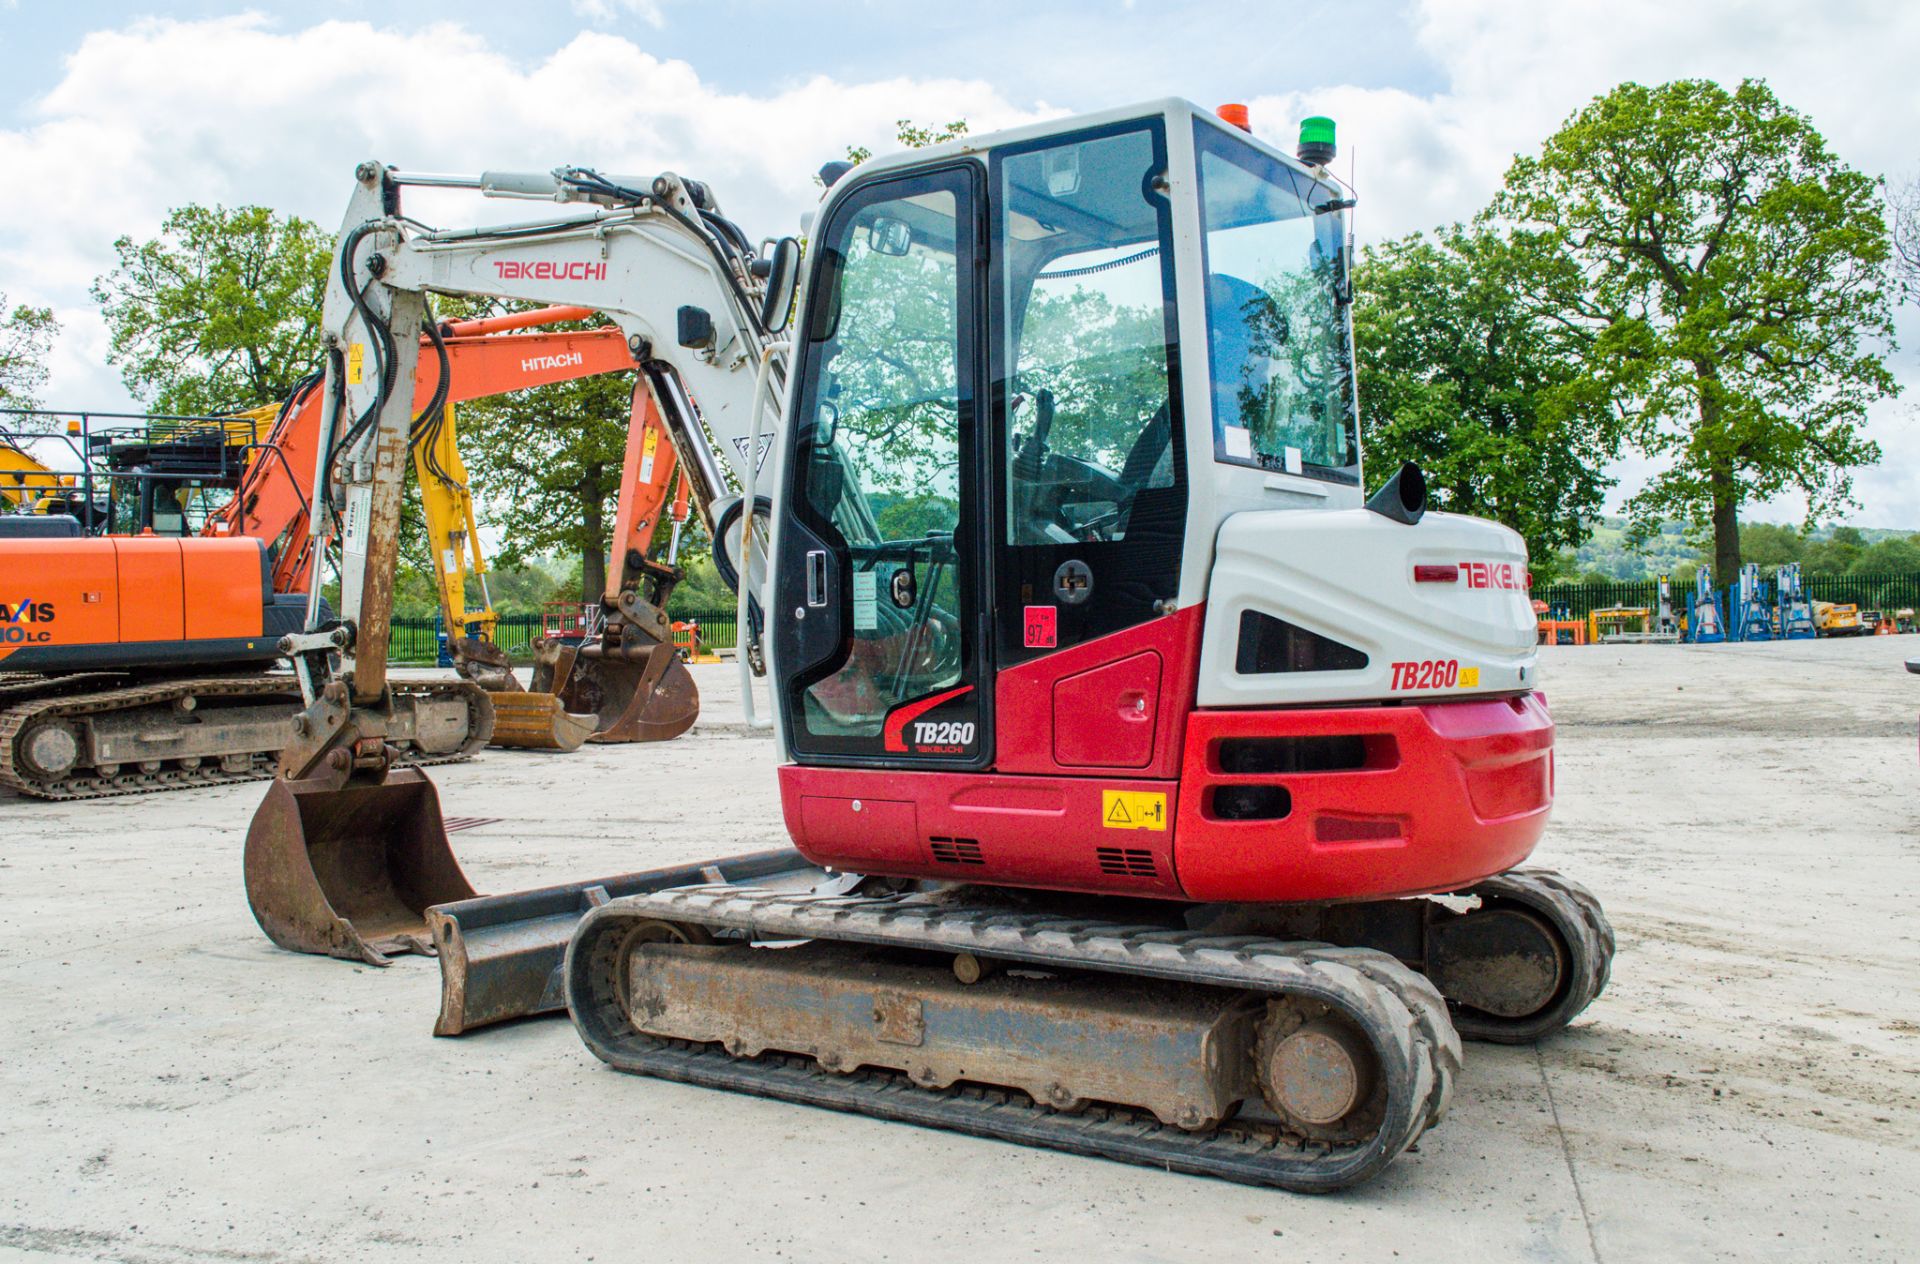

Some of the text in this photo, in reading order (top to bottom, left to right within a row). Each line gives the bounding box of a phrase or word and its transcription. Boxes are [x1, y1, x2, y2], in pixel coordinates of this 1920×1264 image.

[494, 261, 607, 281] TAKEUCHI
[521, 352, 583, 372] HITACHI
[1028, 624, 1043, 644] 97
[1391, 659, 1458, 691] TB260
[914, 722, 975, 745] TB260
